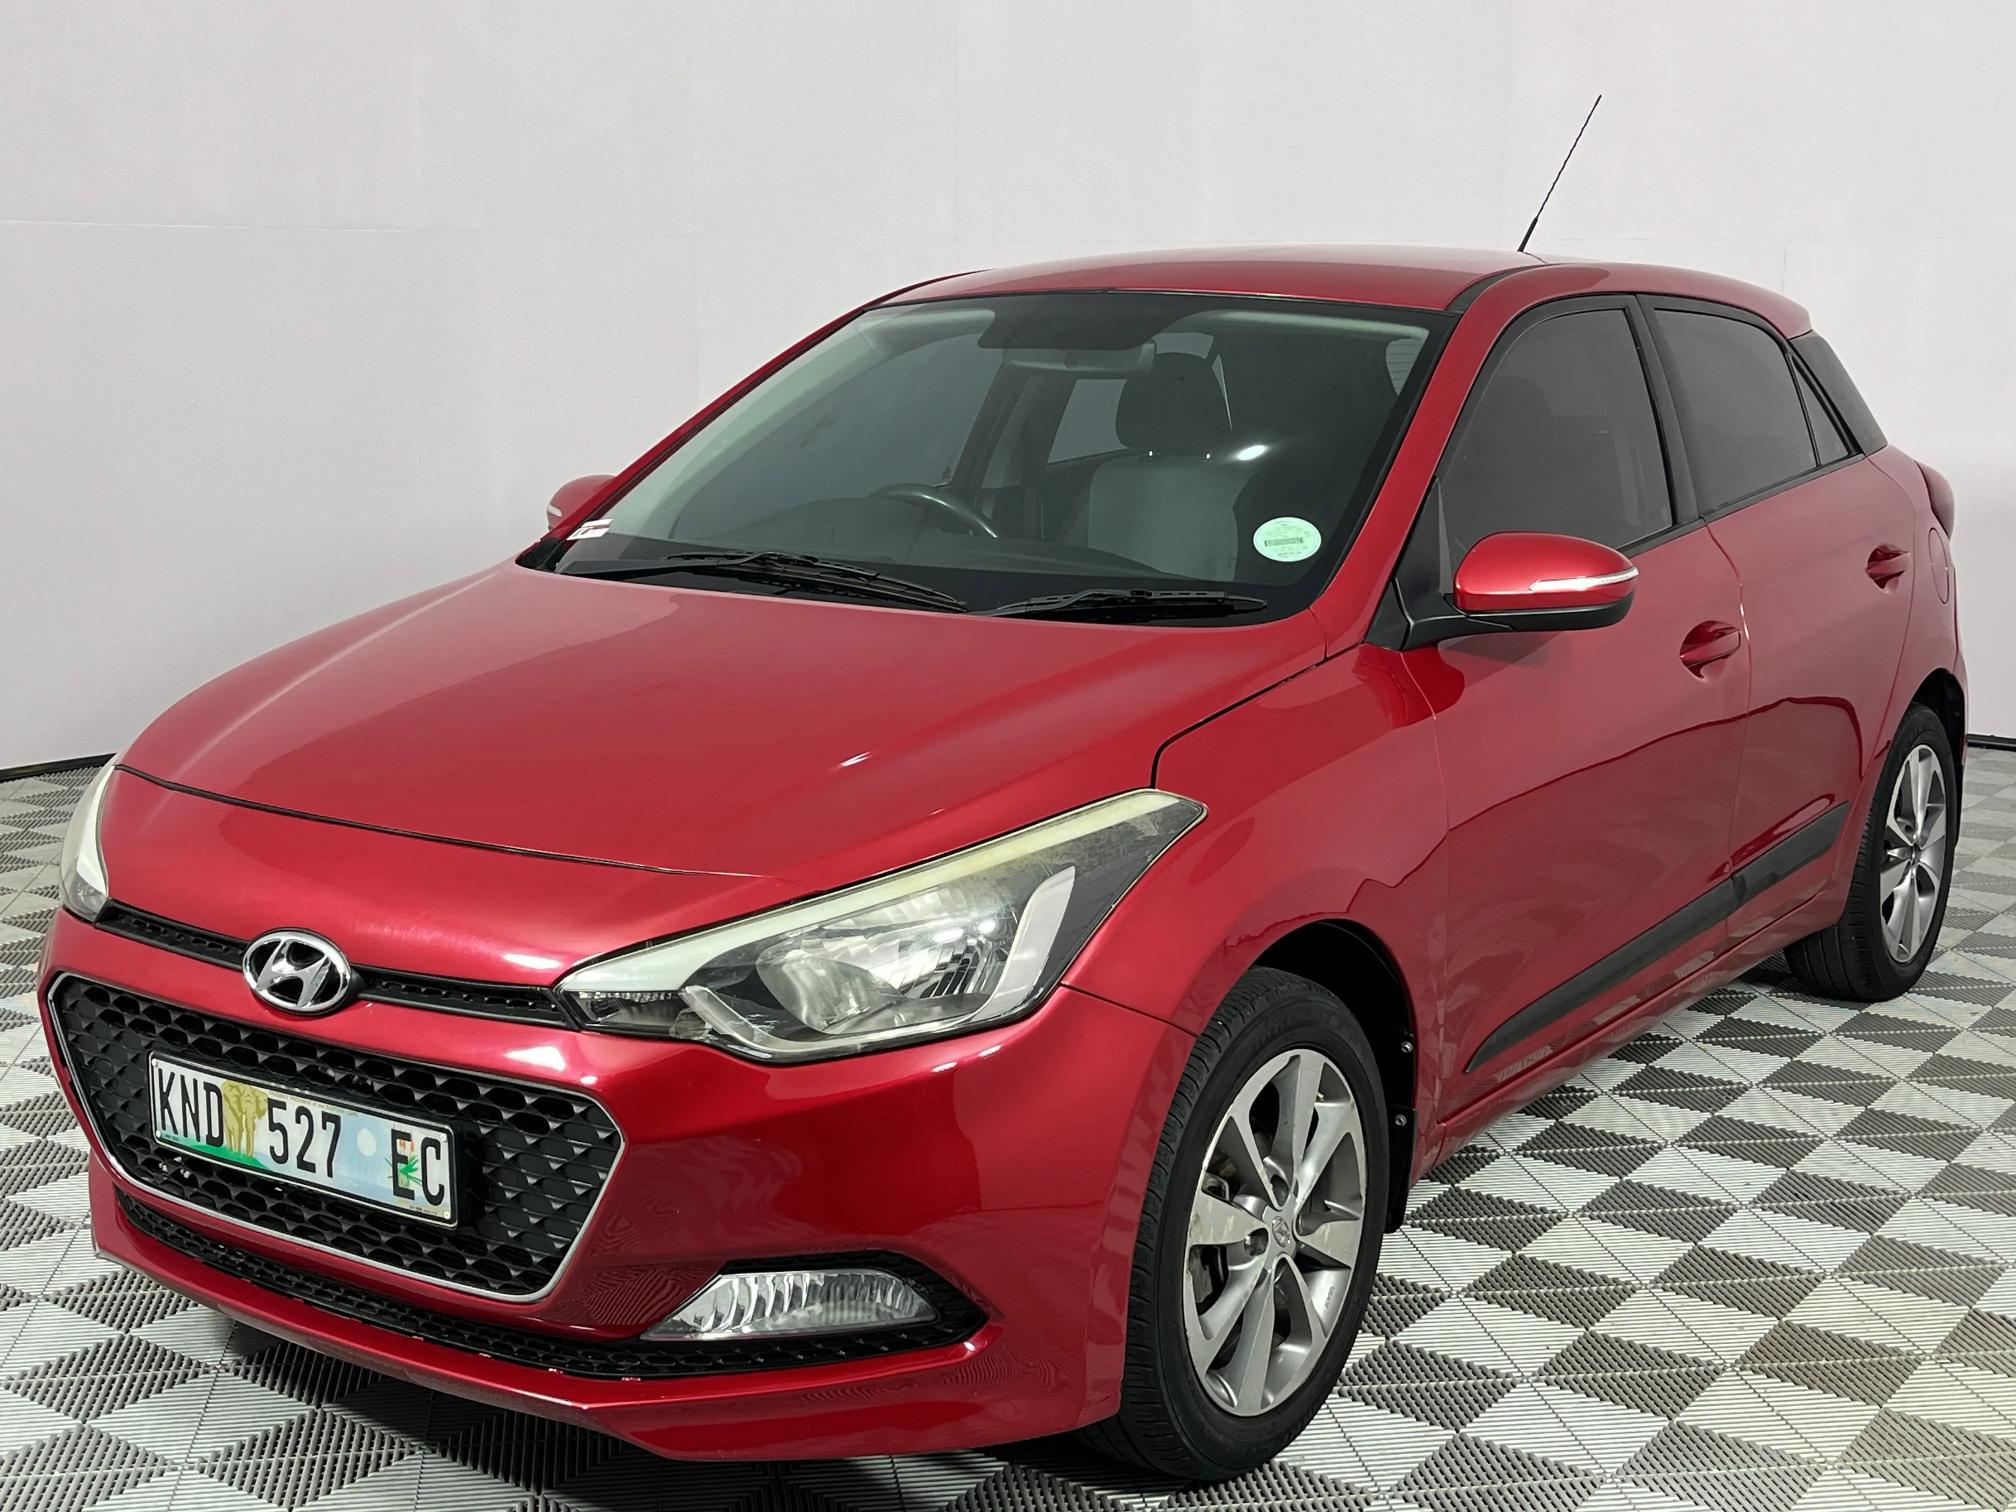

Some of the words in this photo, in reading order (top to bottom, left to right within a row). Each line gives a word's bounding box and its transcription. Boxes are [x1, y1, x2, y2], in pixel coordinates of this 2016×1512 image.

[158, 1068, 224, 1146] KND
[267, 1098, 341, 1178] 527
[391, 1129, 445, 1206] EC
